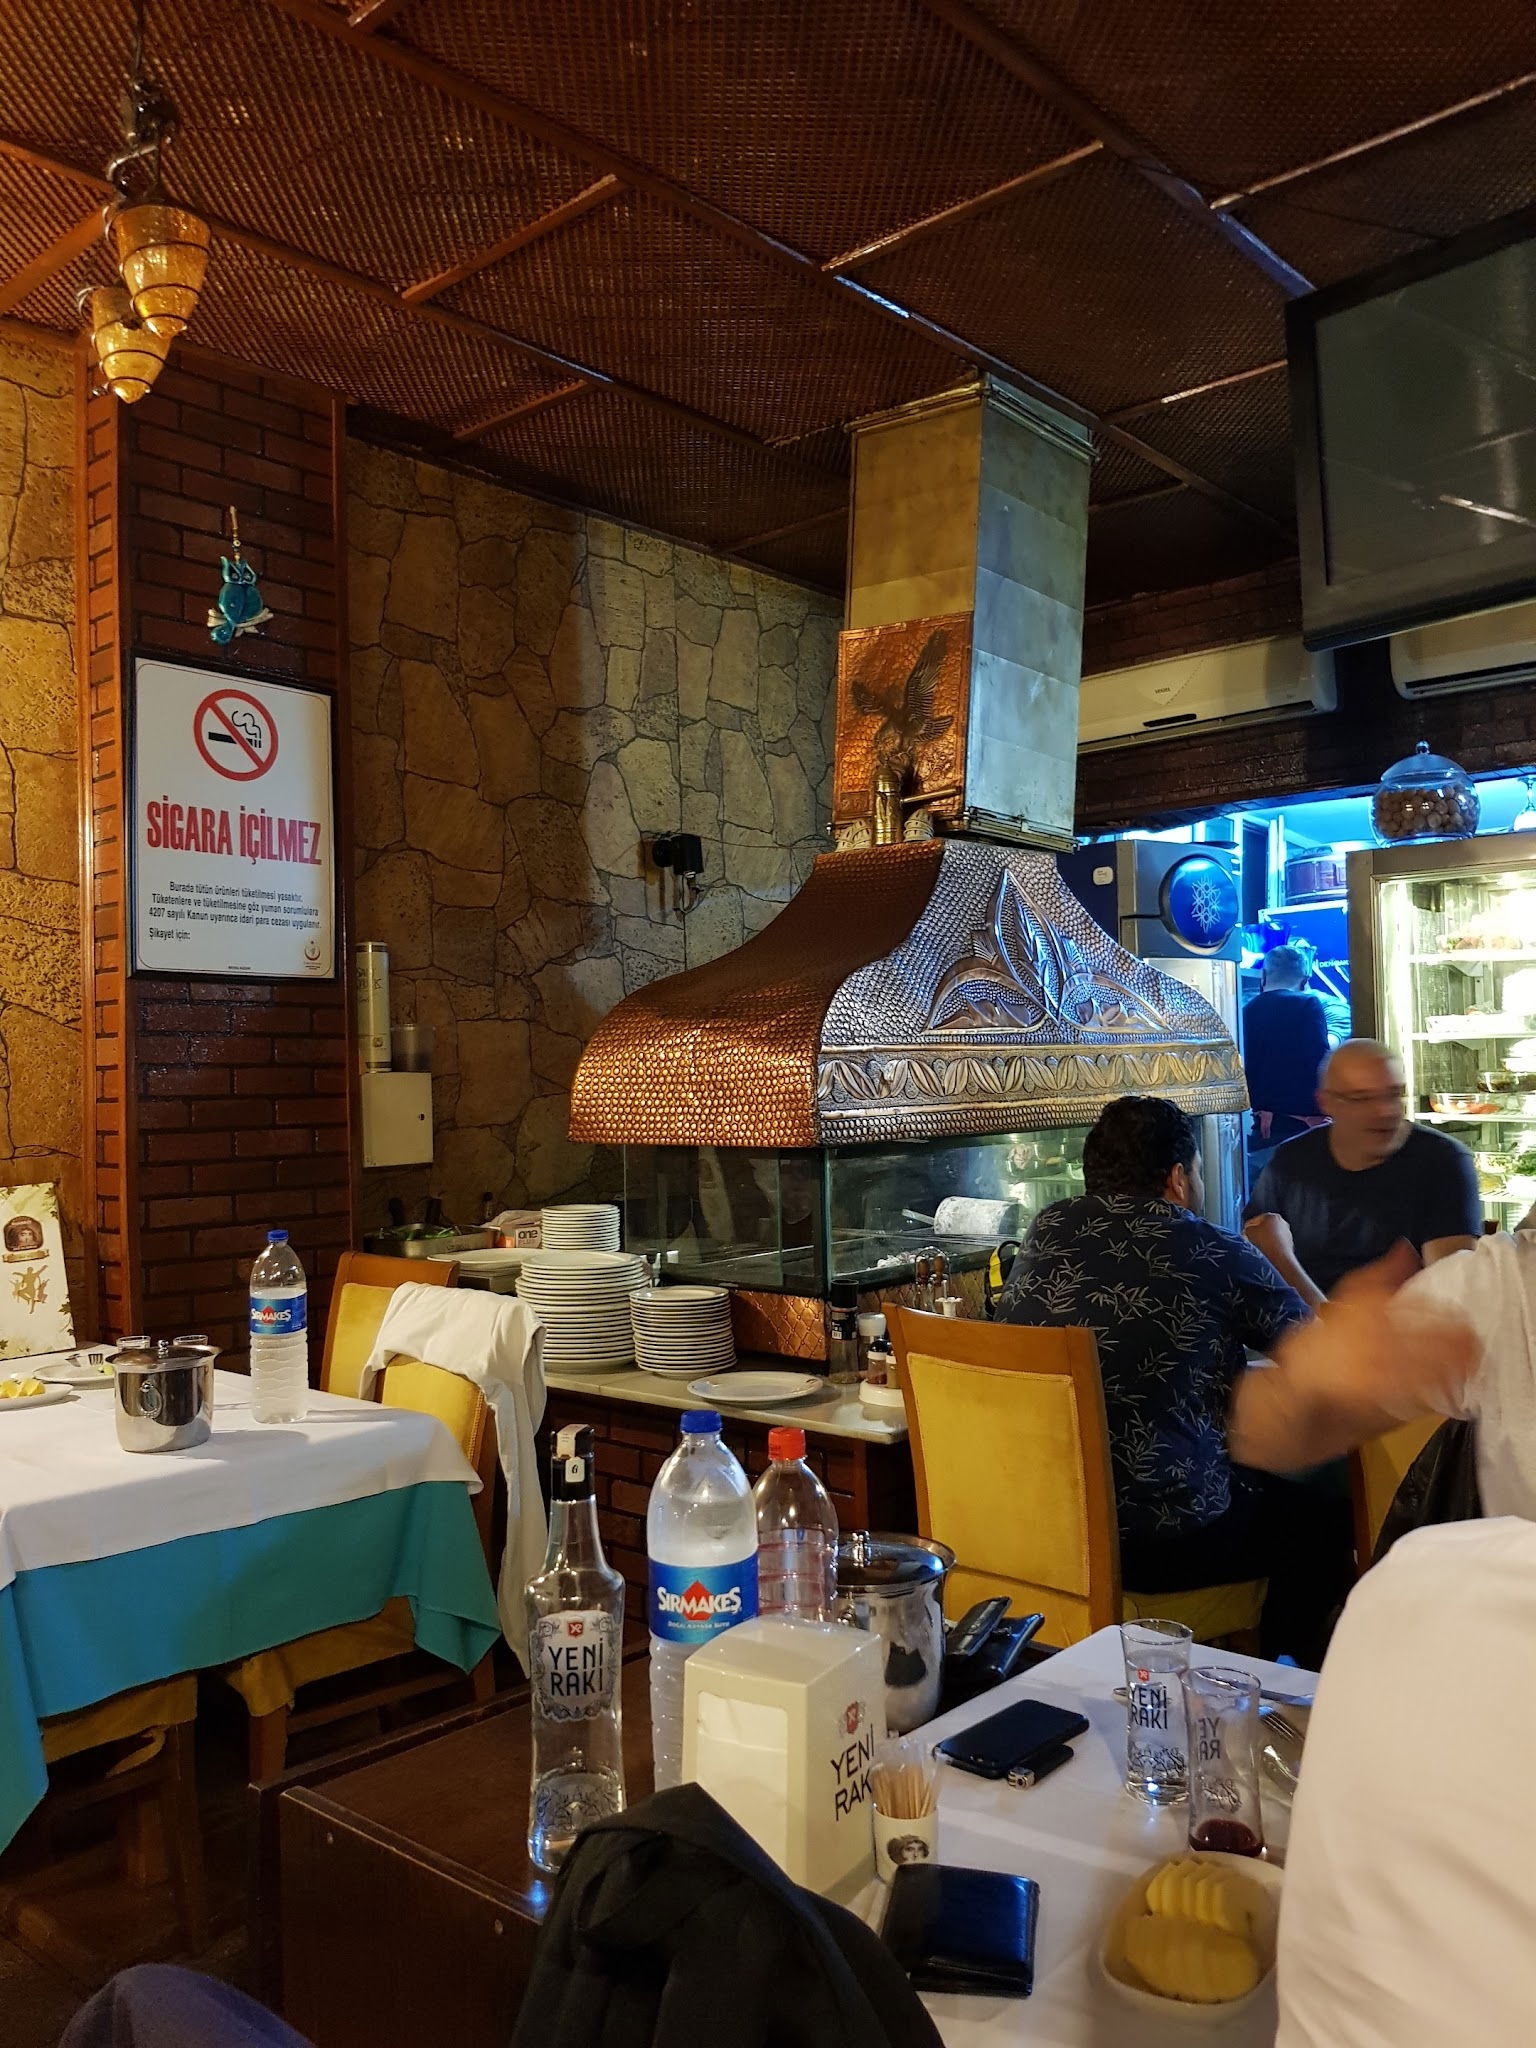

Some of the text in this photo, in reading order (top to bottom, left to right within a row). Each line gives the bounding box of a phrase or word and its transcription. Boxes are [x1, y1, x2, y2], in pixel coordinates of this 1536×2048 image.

[147, 795, 322, 865] SİGARA İÇİLMEZ
[169, 881, 195, 893] Burada
[196, 884, 214, 895] tütün
[214, 885, 240, 897] ürünleri
[241, 887, 276, 900] tüketilmesi
[152, 893, 319, 916] Tüketenlere ve tüketilmesine göz yuman sorumlulara
[149, 907, 166, 918] 4207
[167, 909, 186, 920] sayılı
[187, 910, 209, 920] Kanun
[210, 913, 238, 924] uyarınca
[239, 914, 254, 924] idari
[255, 917, 270, 927] para
[271, 918, 291, 927] cezası
[149, 927, 174, 941] Şikayet
[518, 1229, 538, 1239] one
[548, 1637, 604, 1671] YENİ
[550, 1668, 603, 1697] RAKI
[1130, 1685, 1168, 1708] YENİ
[1130, 1703, 1168, 1729] RAKI
[835, 1767, 873, 1822] RAK
